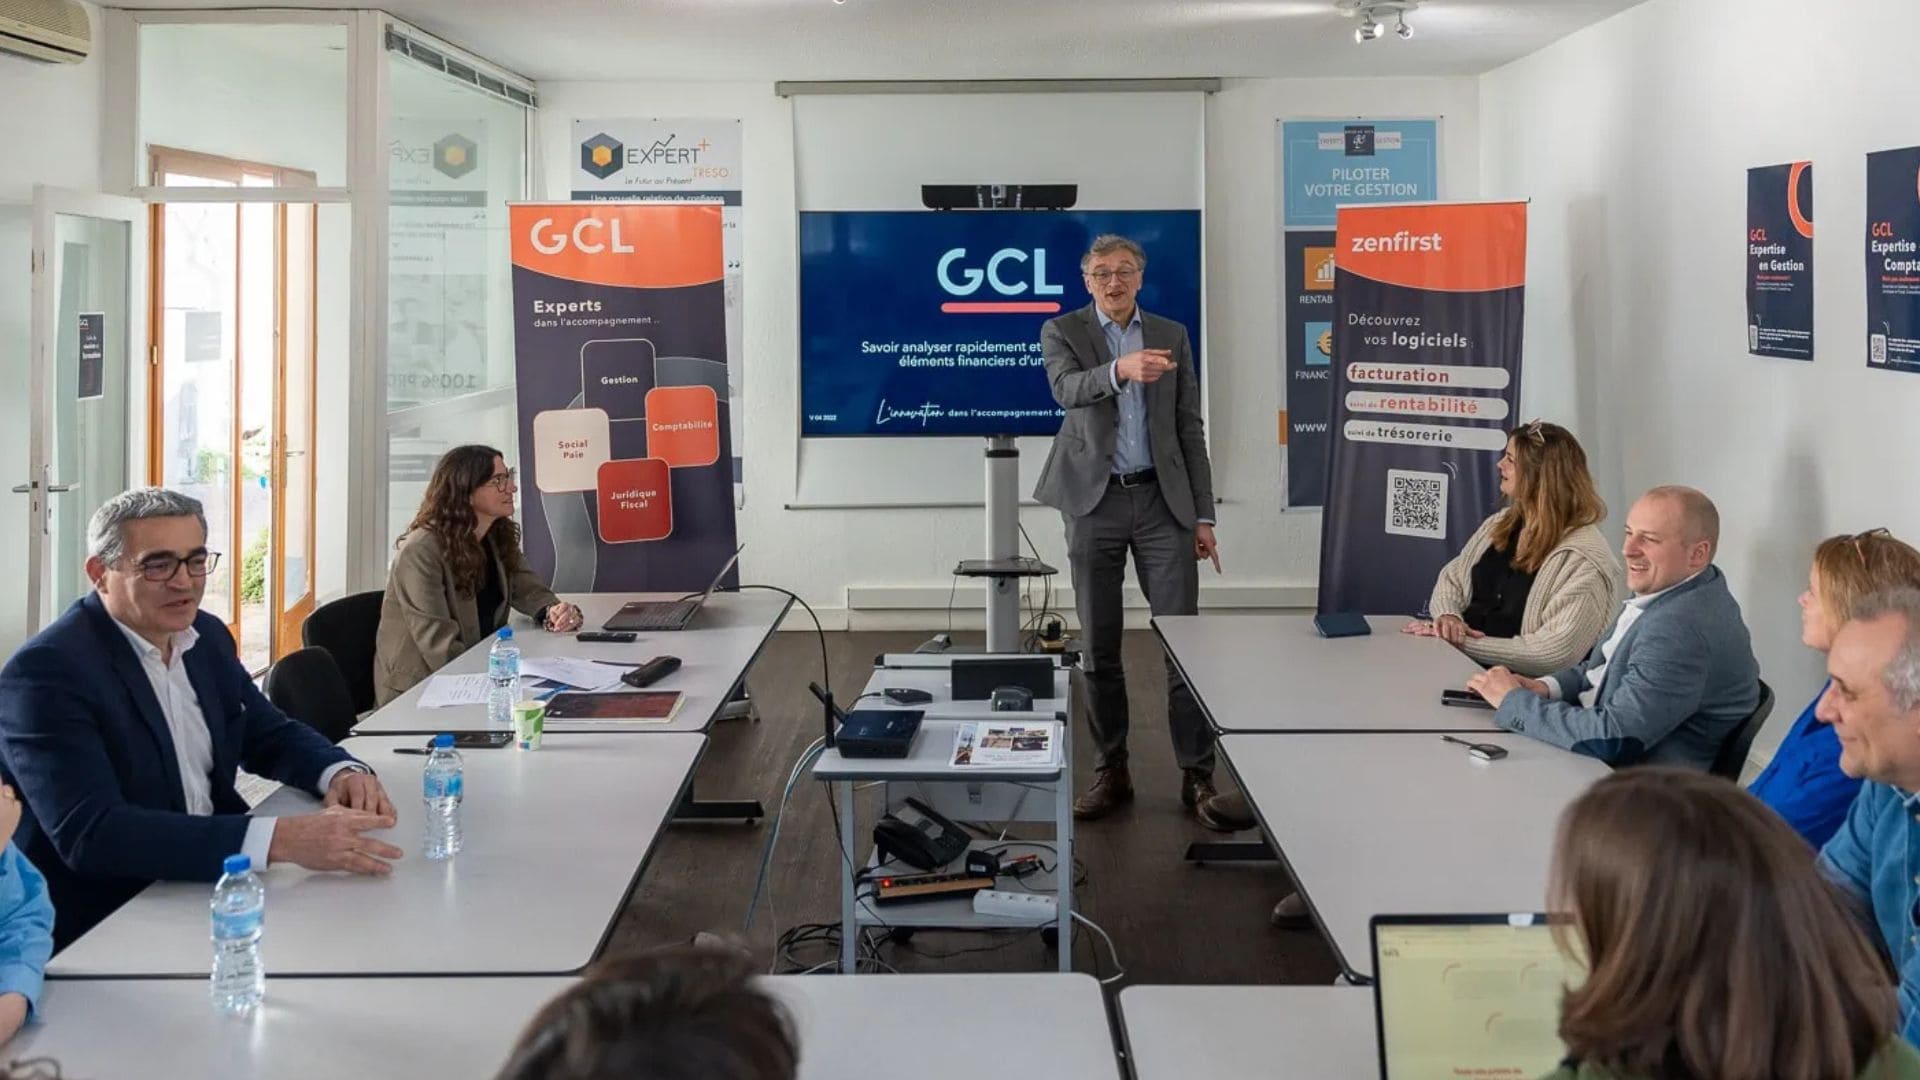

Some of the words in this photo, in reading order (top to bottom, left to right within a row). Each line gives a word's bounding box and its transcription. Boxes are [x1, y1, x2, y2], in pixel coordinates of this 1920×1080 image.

[627, 148, 700, 164] EXPERT
[1332, 167, 1391, 180] PILOTER
[1304, 184, 1351, 197] VOTRE
[1354, 183, 1418, 197] GESTION
[530, 218, 634, 254] GCL
[1750, 228, 1768, 241] GCL
[1872, 222, 1893, 237] GCL
[1352, 231, 1442, 253] zenfirst
[1871, 238, 1917, 256] Expertise
[1750, 243, 1786, 257] Expertise
[937, 248, 1063, 296] GCL
[1759, 262, 1769, 271] en
[1770, 259, 1804, 271] Gestion
[534, 299, 602, 315] Experts
[534, 317, 558, 328] dans
[560, 316, 652, 329] l'accompagnement
[1348, 313, 1420, 327] Découvrez
[1364, 335, 1387, 346] vos
[1392, 331, 1468, 350] logiciels
[861, 340, 900, 354] Savoir
[902, 340, 952, 356] analyser
[955, 340, 1026, 355] rapidement
[1029, 341, 1042, 353] et
[898, 355, 955, 367] éléments
[958, 355, 1016, 367] financiers
[601, 375, 638, 385] Gestion
[1350, 364, 1450, 383] facturation
[1379, 396, 1478, 415] rentabilité
[948, 408, 969, 417] dans
[970, 408, 1052, 419] l'accompagnement
[652, 420, 713, 432] Comptabilité
[1377, 426, 1453, 443] trésorerie
[558, 440, 588, 449] Social
[563, 451, 584, 460] Paie
[611, 490, 657, 502] Juridique
[620, 500, 648, 510] Fiscal
